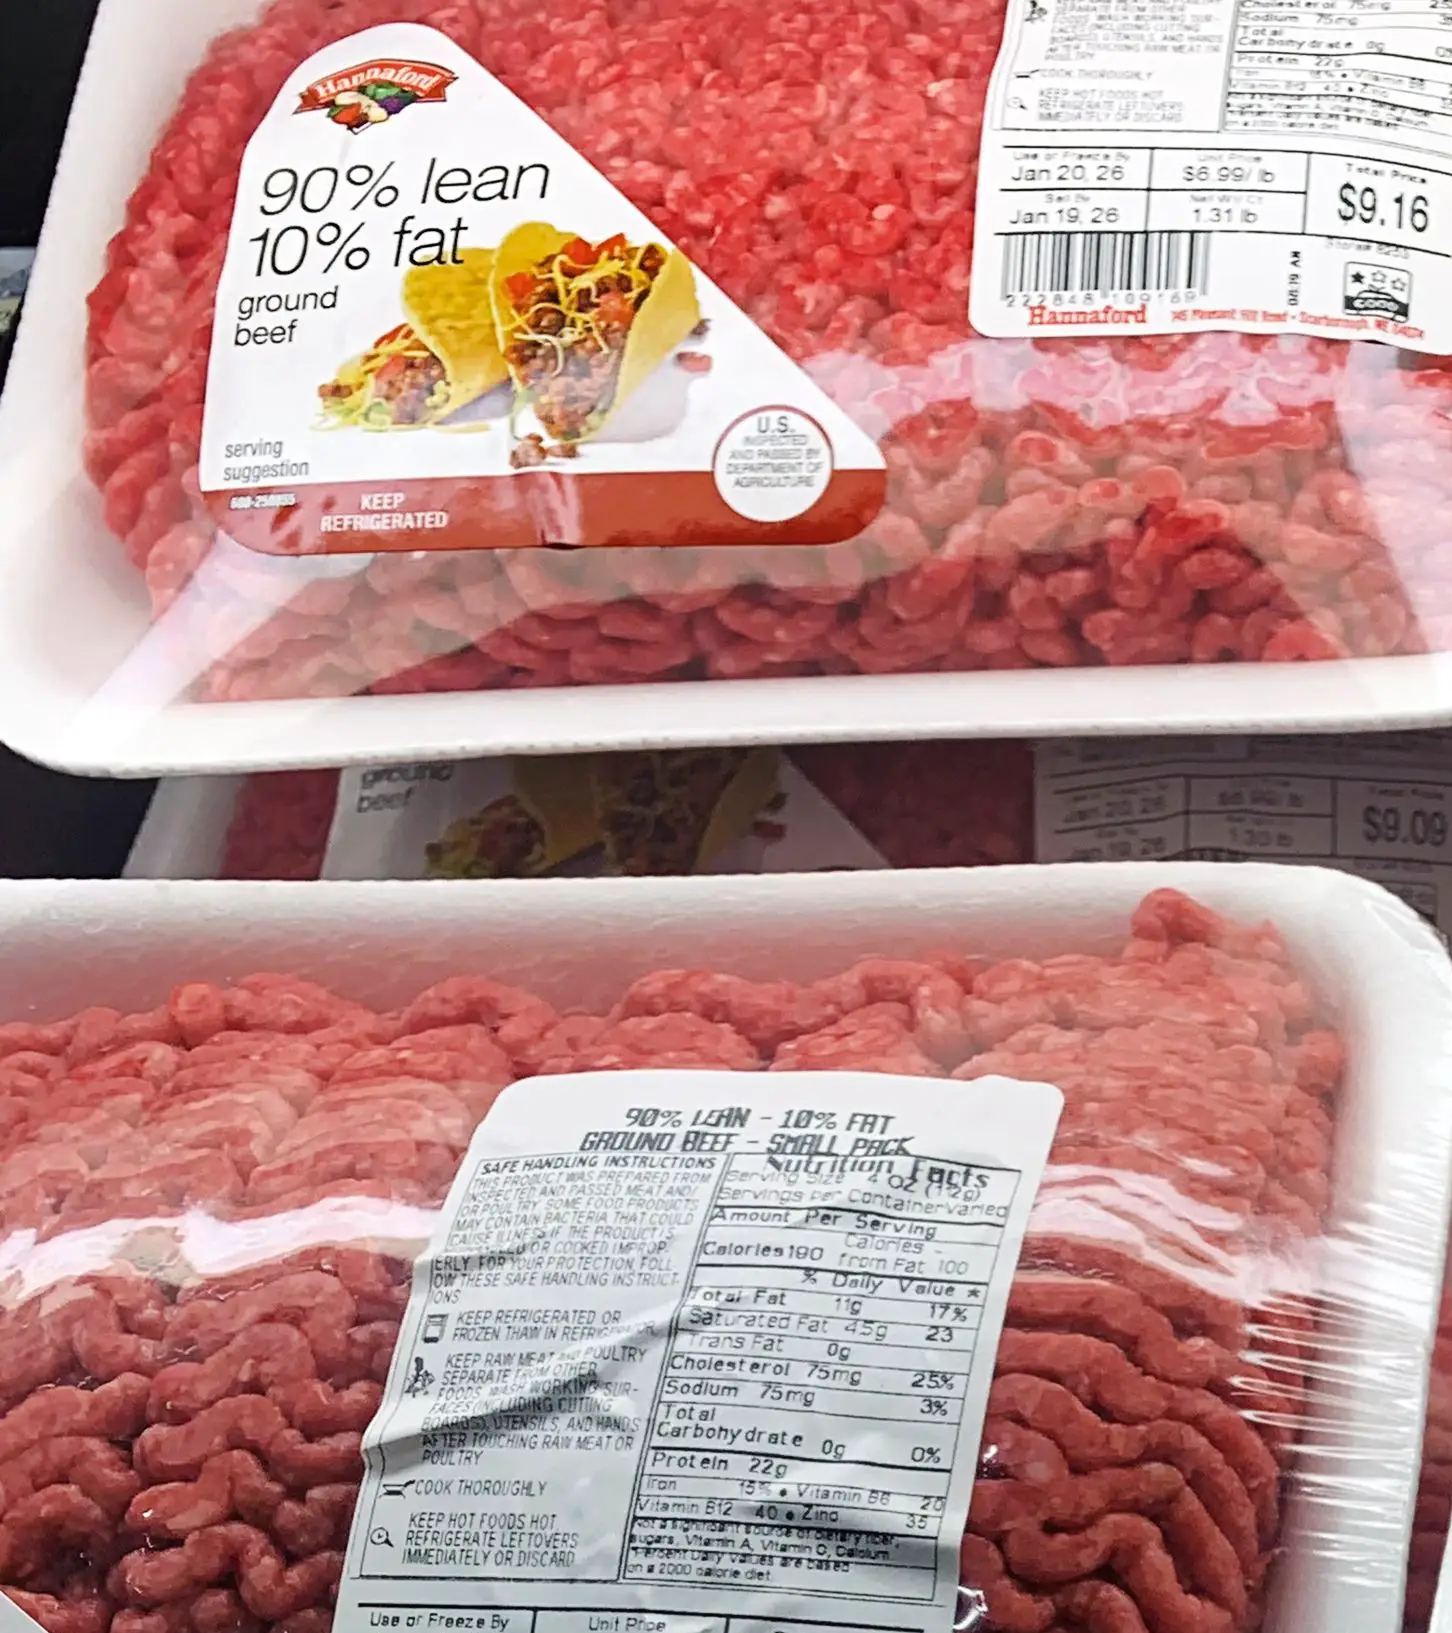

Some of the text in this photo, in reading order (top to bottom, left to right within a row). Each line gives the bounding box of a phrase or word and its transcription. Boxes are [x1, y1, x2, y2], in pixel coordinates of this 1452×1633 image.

[314, 61, 441, 100] Hannaford
[258, 158, 550, 217] 90% lean
[1338, 182, 1429, 234] $9.16
[249, 216, 469, 278] 10% fat
[236, 286, 339, 320] ground
[1028, 305, 1148, 325] Hannaford
[234, 320, 298, 347] beef
[755, 415, 797, 435] U.S.
[225, 438, 284, 459] serving
[222, 458, 310, 481] suggestion
[359, 492, 405, 511] KEEP
[320, 509, 449, 532] REFRIGERATED
[1362, 805, 1448, 847] $9.09
[625, 1108, 684, 1128] 90%
[779, 1109, 837, 1131] 10%
[579, 1131, 678, 1153] GROUND
[681, 1129, 739, 1151] BEEF
